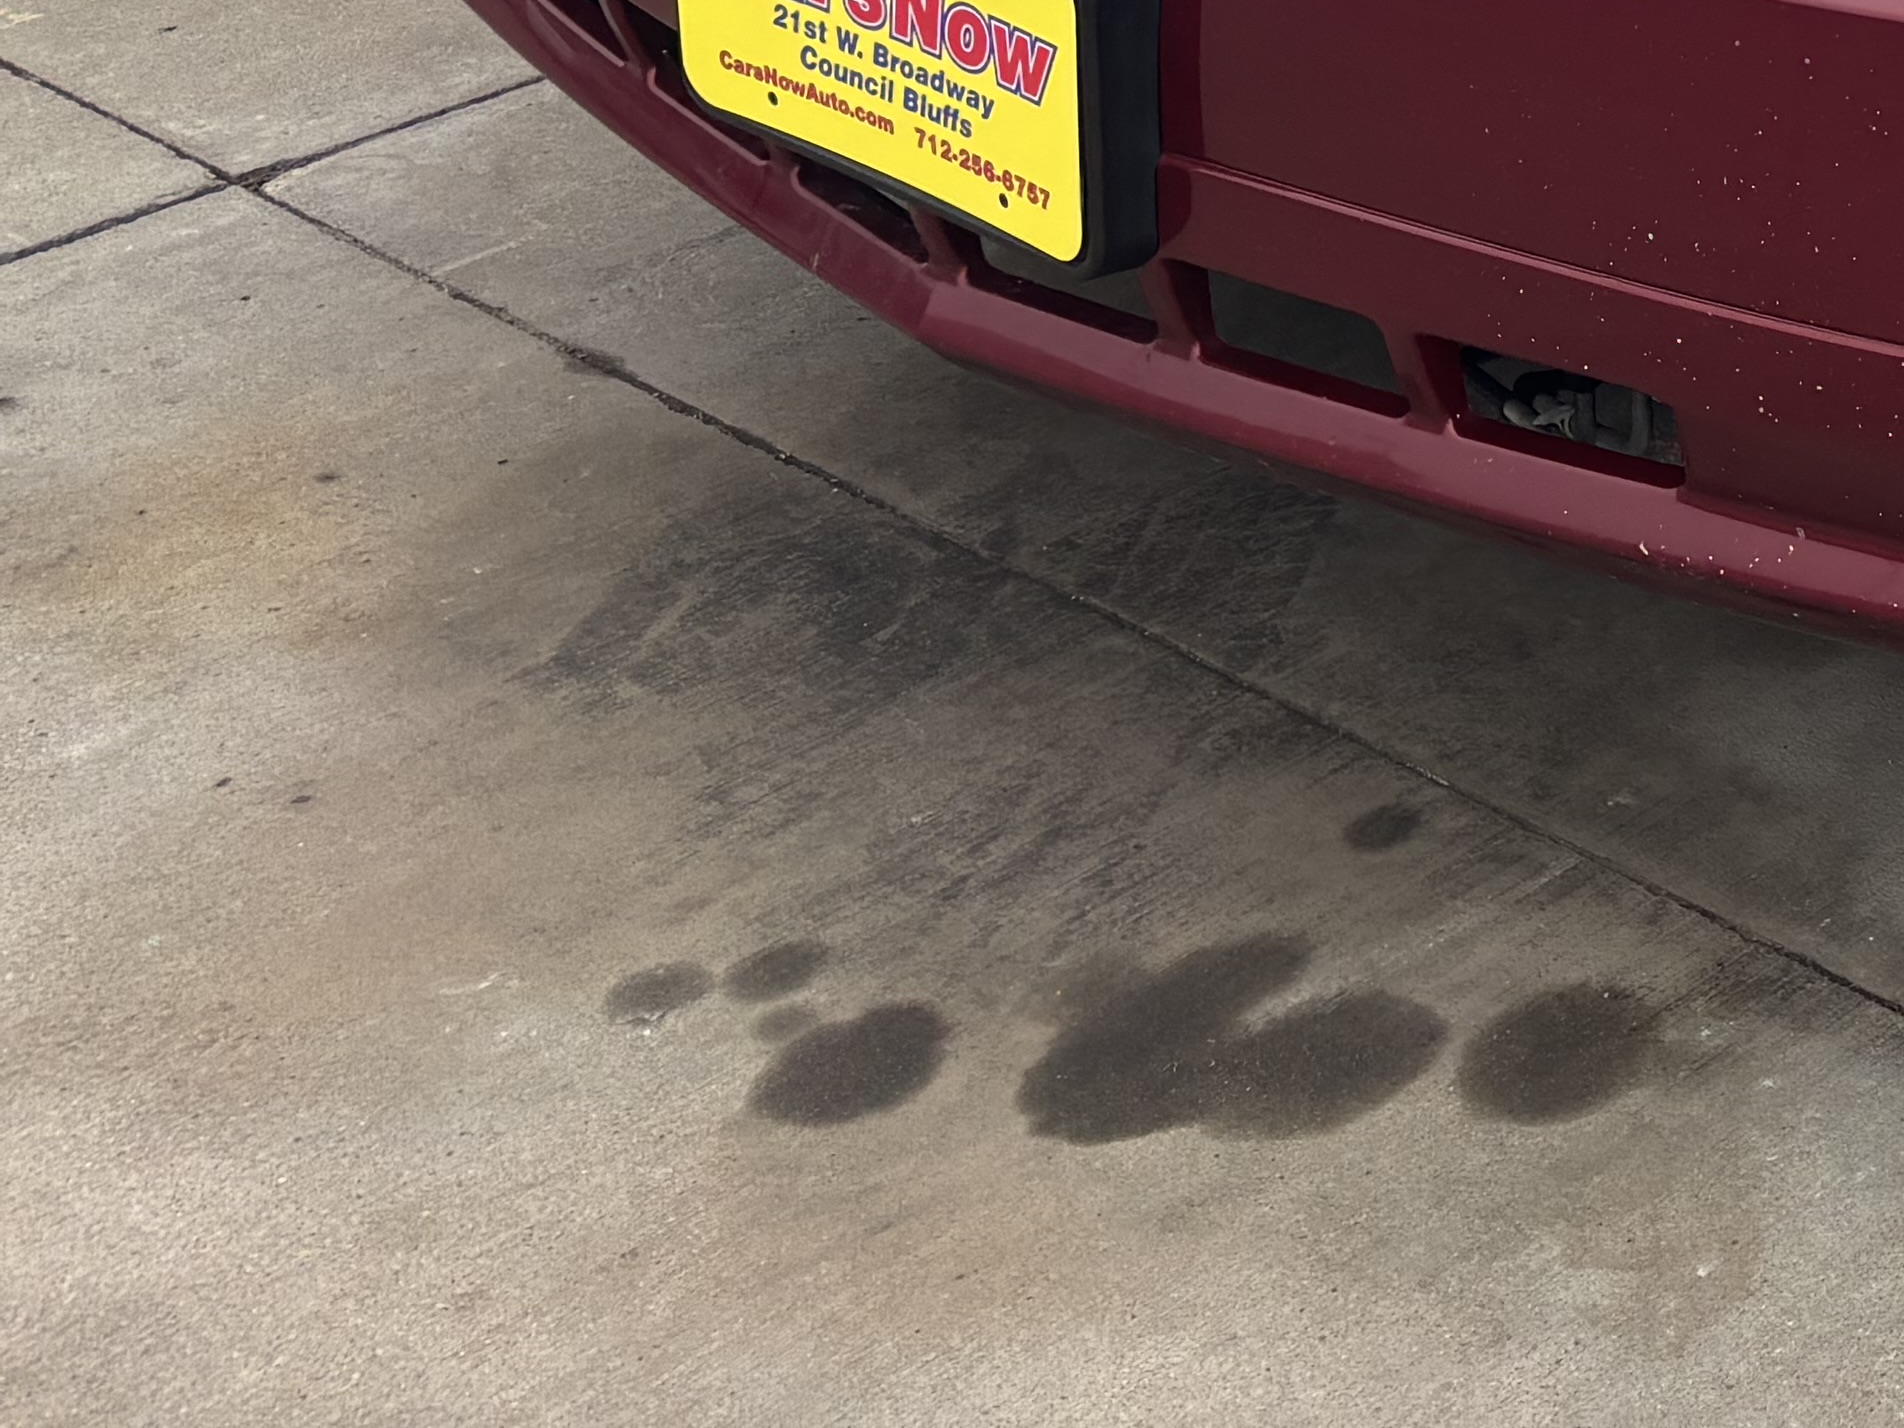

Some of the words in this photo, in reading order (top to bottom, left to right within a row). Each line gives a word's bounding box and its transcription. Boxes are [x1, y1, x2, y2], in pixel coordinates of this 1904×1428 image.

[719, 50, 895, 135] CarsNowAuto.com
[773, 4, 827, 44] 21st
[836, 26, 864, 59] W.
[873, 41, 995, 120] Broadway
[800, 45, 893, 104] Council
[903, 90, 972, 139] Bluffs
